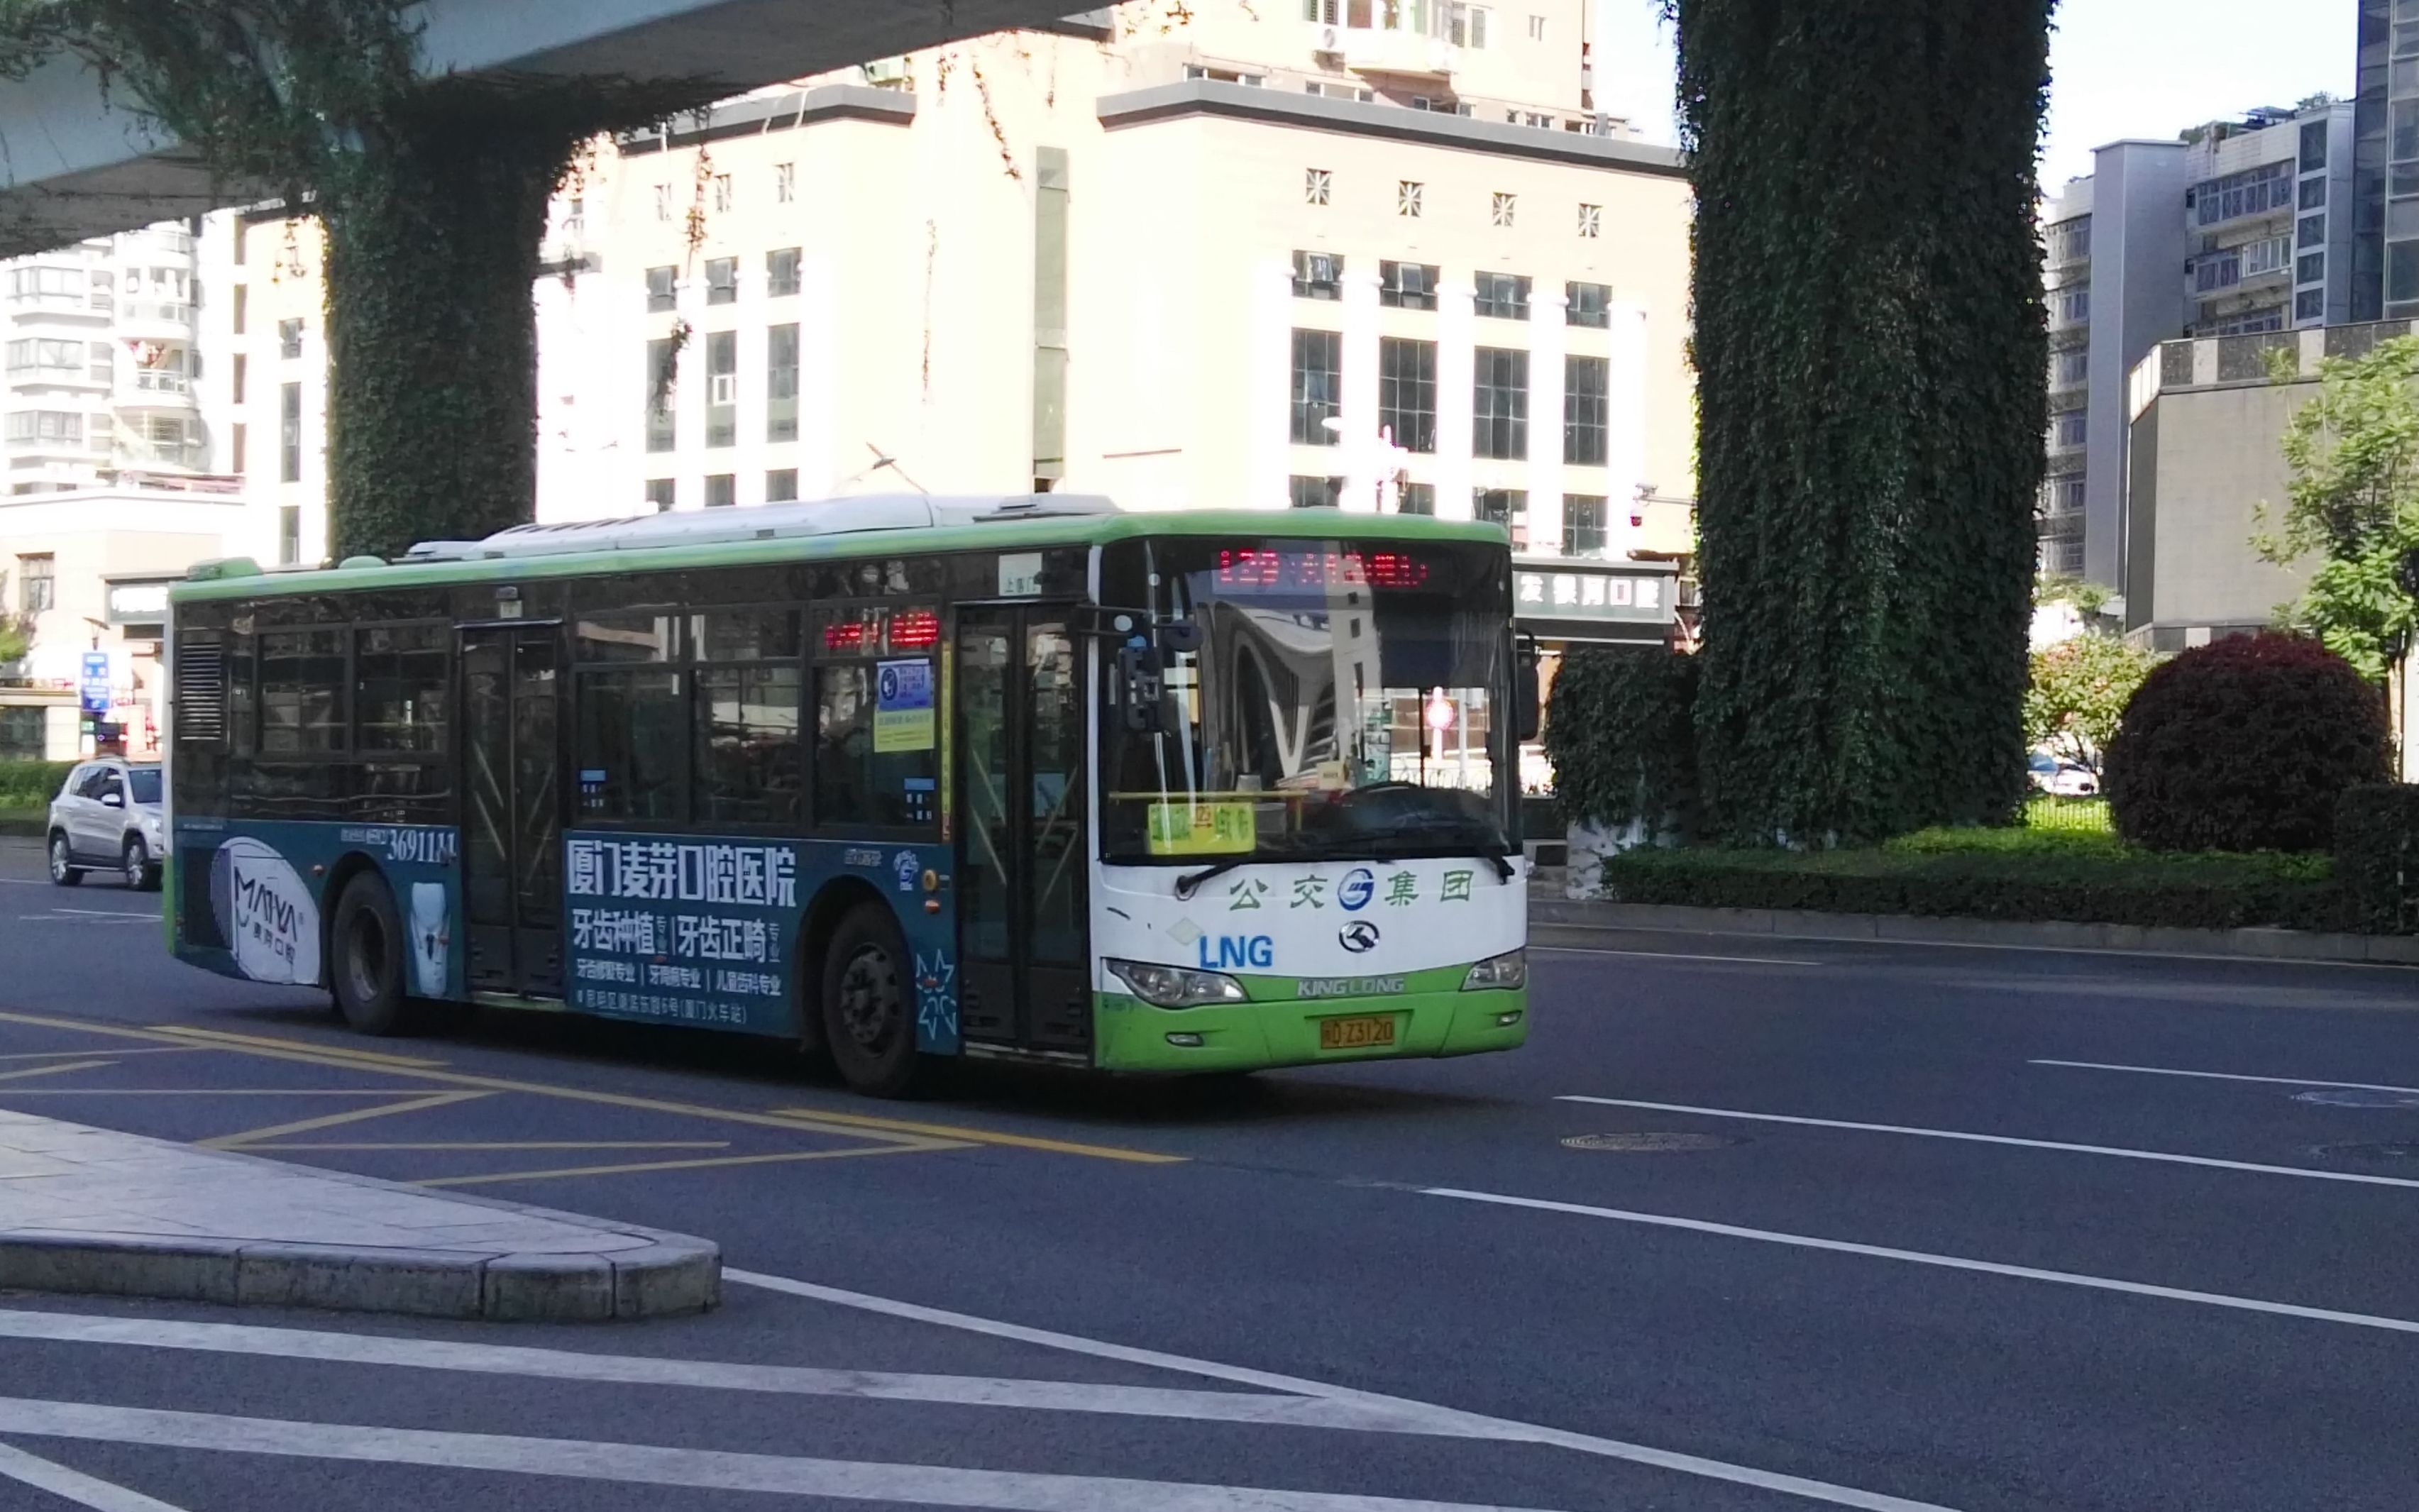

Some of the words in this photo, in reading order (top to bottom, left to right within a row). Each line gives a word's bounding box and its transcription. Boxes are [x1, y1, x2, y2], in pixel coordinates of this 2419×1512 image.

[567, 839, 797, 907] 厦门麦芽口腔医院
[572, 908, 655, 955] 牙齿种植
[677, 915, 766, 964] 牙齿正畸
[1199, 935, 1273, 970] LNG
